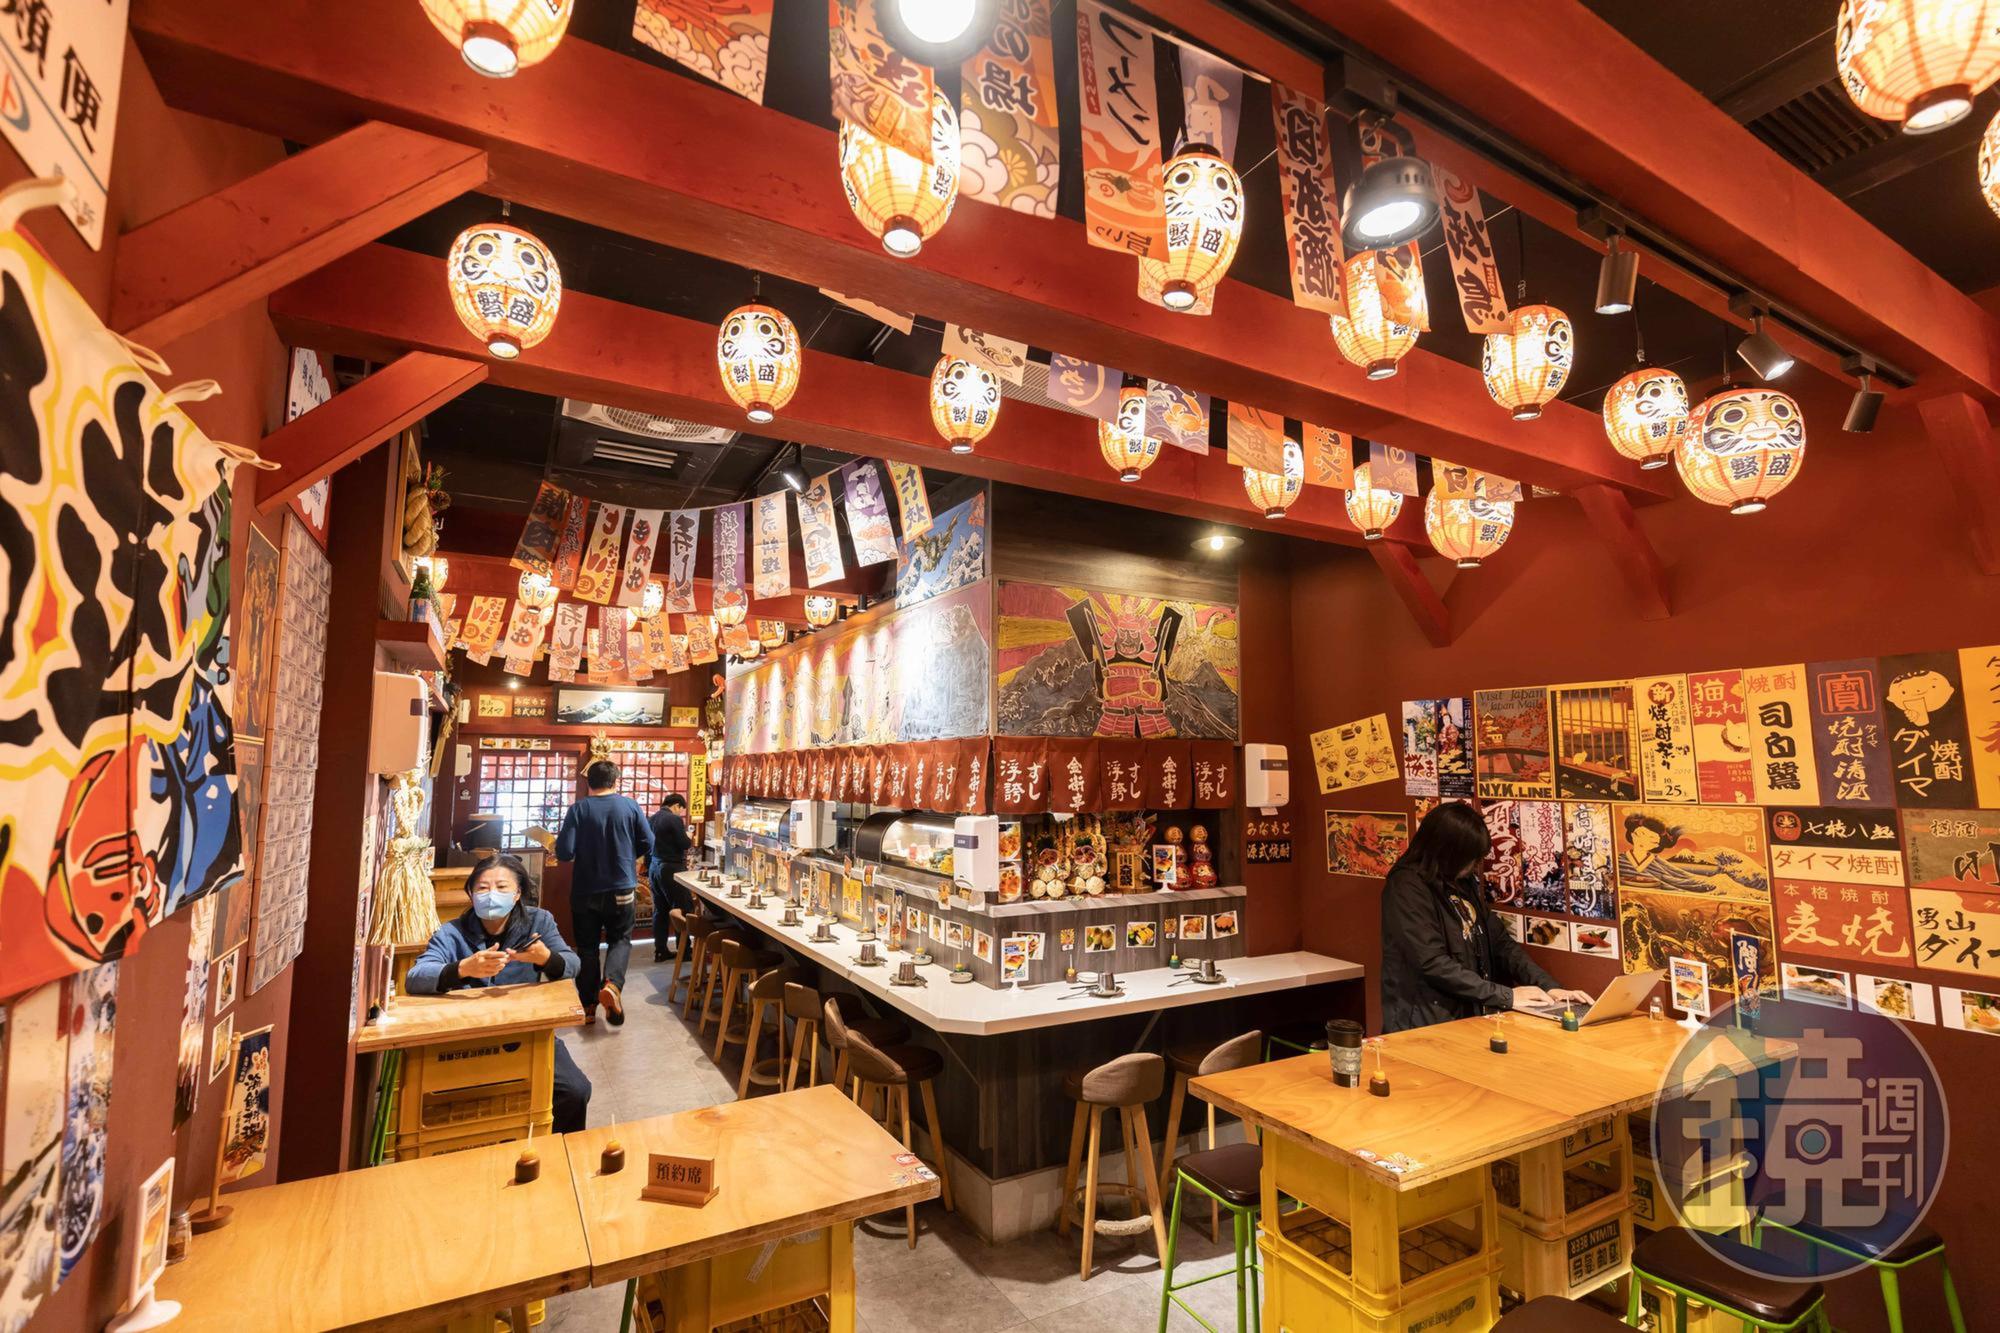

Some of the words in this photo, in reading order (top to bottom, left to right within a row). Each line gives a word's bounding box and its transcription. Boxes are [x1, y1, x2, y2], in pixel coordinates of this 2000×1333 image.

[1168, 221, 1220, 255] 繁盛
[476, 289, 534, 326] 繁盛
[733, 364, 776, 383] 繁盛
[1729, 453, 1793, 480] 繁盛
[1693, 678, 1725, 702] 猫
[1747, 671, 1797, 694] 焼酎
[1930, 740, 1963, 781] 焼酎
[1027, 761, 1042, 801] すし
[1129, 762, 1141, 799] すし
[1216, 763, 1228, 798] すし
[1518, 786, 1552, 799] LINE
[1665, 784, 1682, 797] 25
[1247, 821, 1291, 837] みなもと
[1775, 850, 1901, 876] ダイマ焼酎
[1784, 883, 1890, 905] 本格焼酎
[1917, 908, 1976, 932] 男山
[655, 1161, 705, 1186] 預約席
